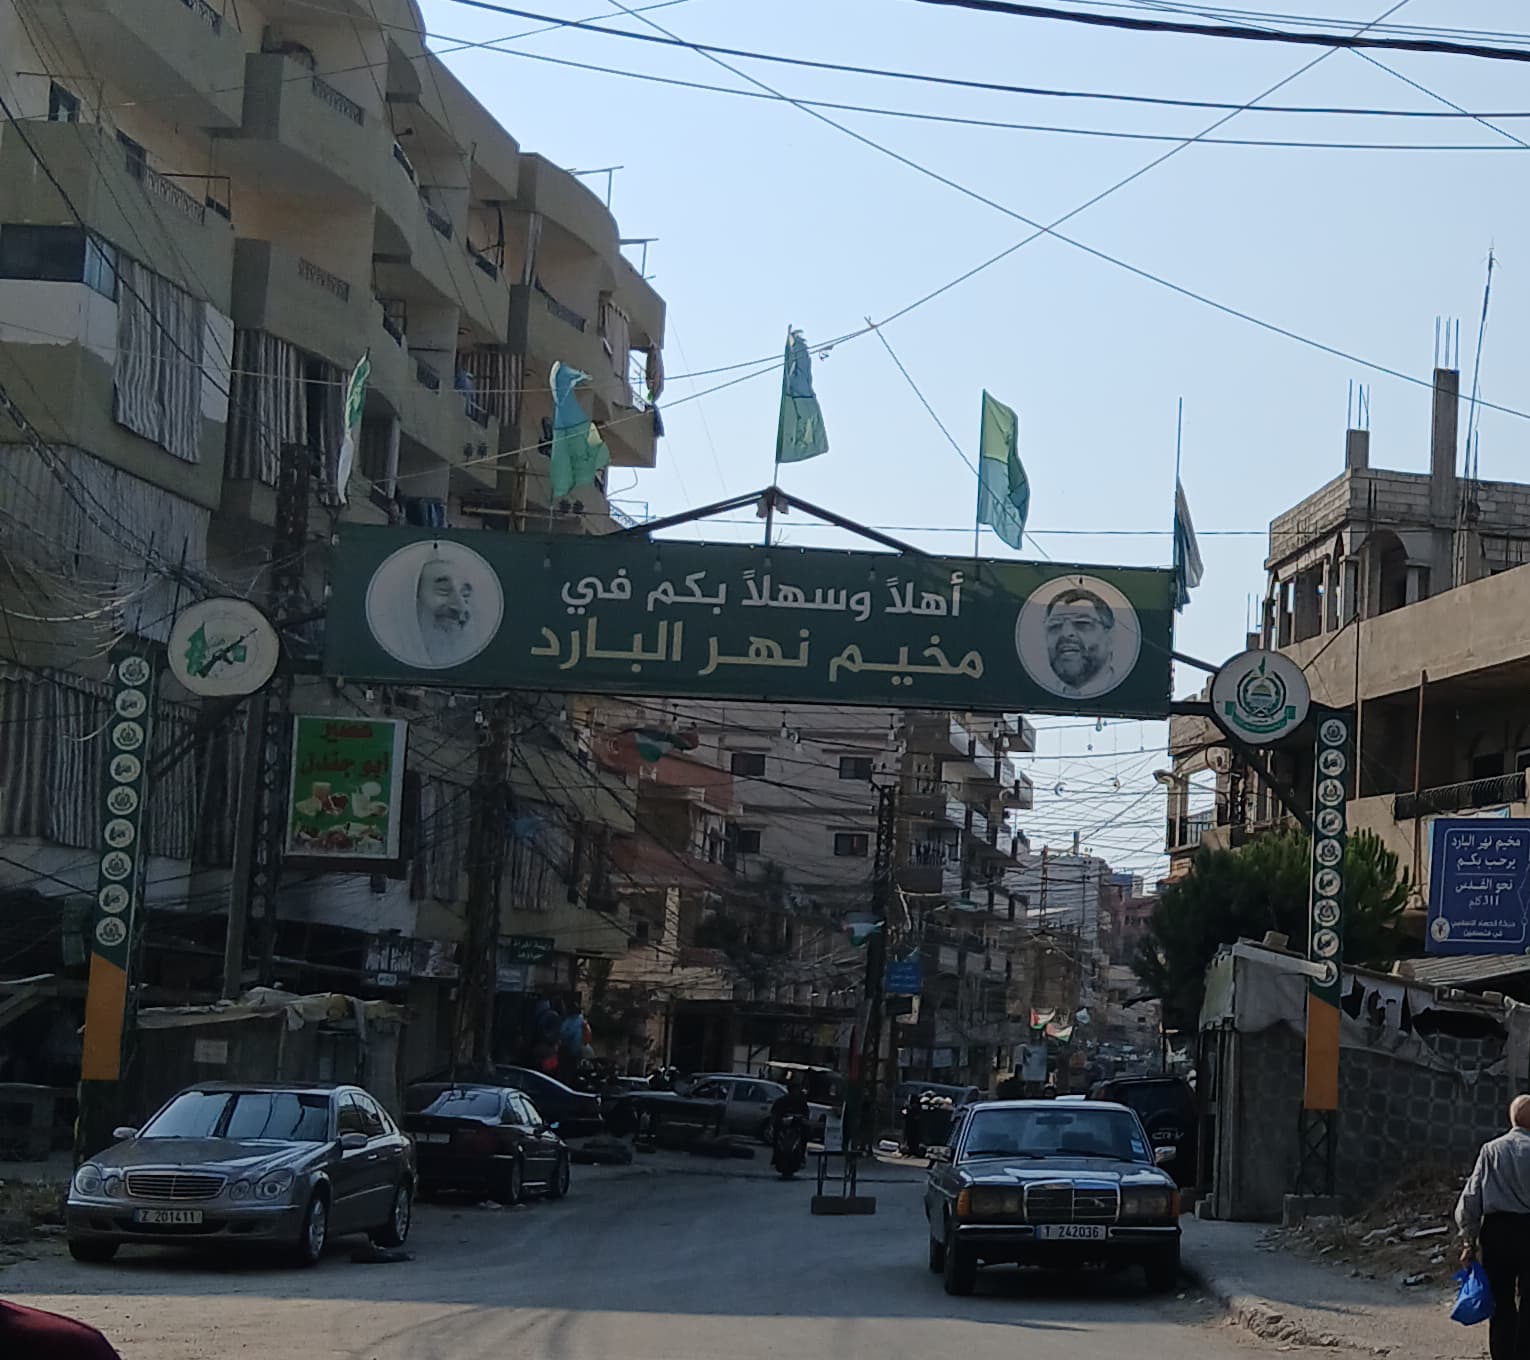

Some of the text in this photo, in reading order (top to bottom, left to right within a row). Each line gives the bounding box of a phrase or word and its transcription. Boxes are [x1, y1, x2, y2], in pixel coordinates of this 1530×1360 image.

[561, 568, 965, 622] أهلاً وسهلاً بكم في
[530, 616, 985, 686] مخيم نهر البارد
[1451, 833, 1521, 852] مخيم نهر البارد
[1456, 852, 1517, 871] يرحب بكم
[1455, 877, 1513, 893] نحو القدس
[1058, 1225, 1099, 1238] 242036
